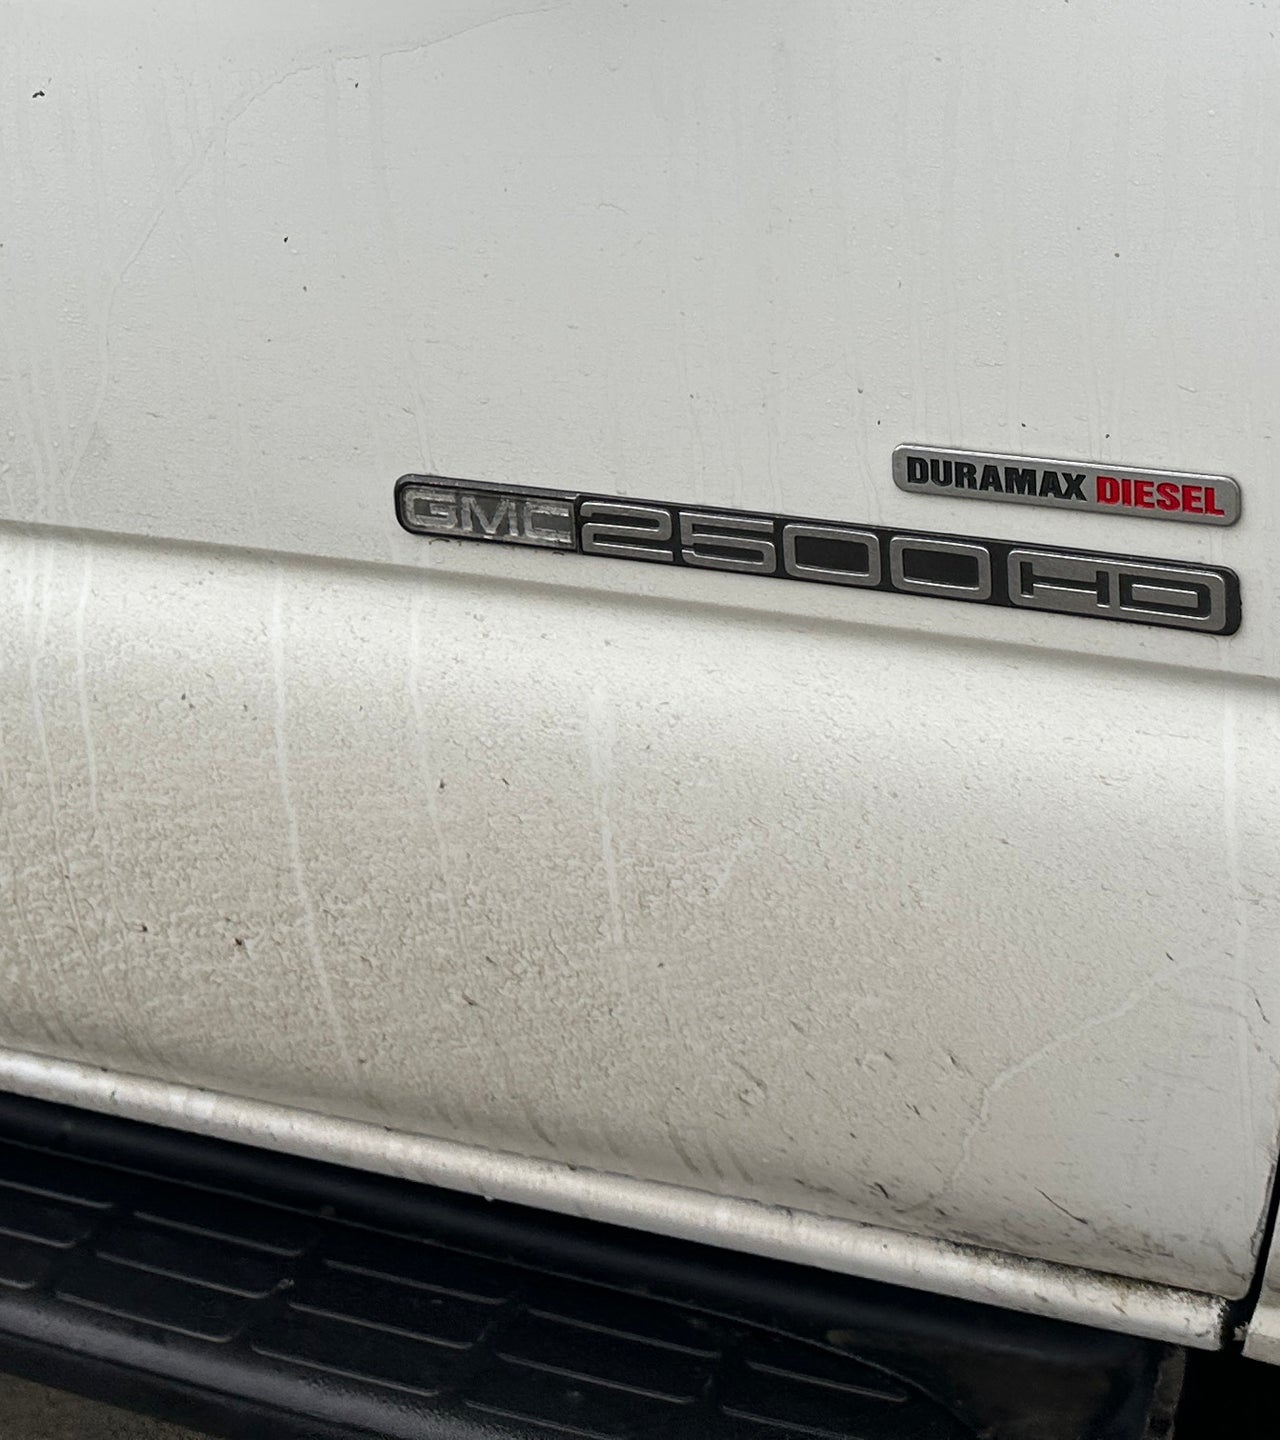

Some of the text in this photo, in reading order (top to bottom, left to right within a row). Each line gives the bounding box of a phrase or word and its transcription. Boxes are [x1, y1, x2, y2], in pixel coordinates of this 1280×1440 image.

[401, 486, 573, 546] GMC
[906, 455, 1225, 517] DURAMAX DIESEL
